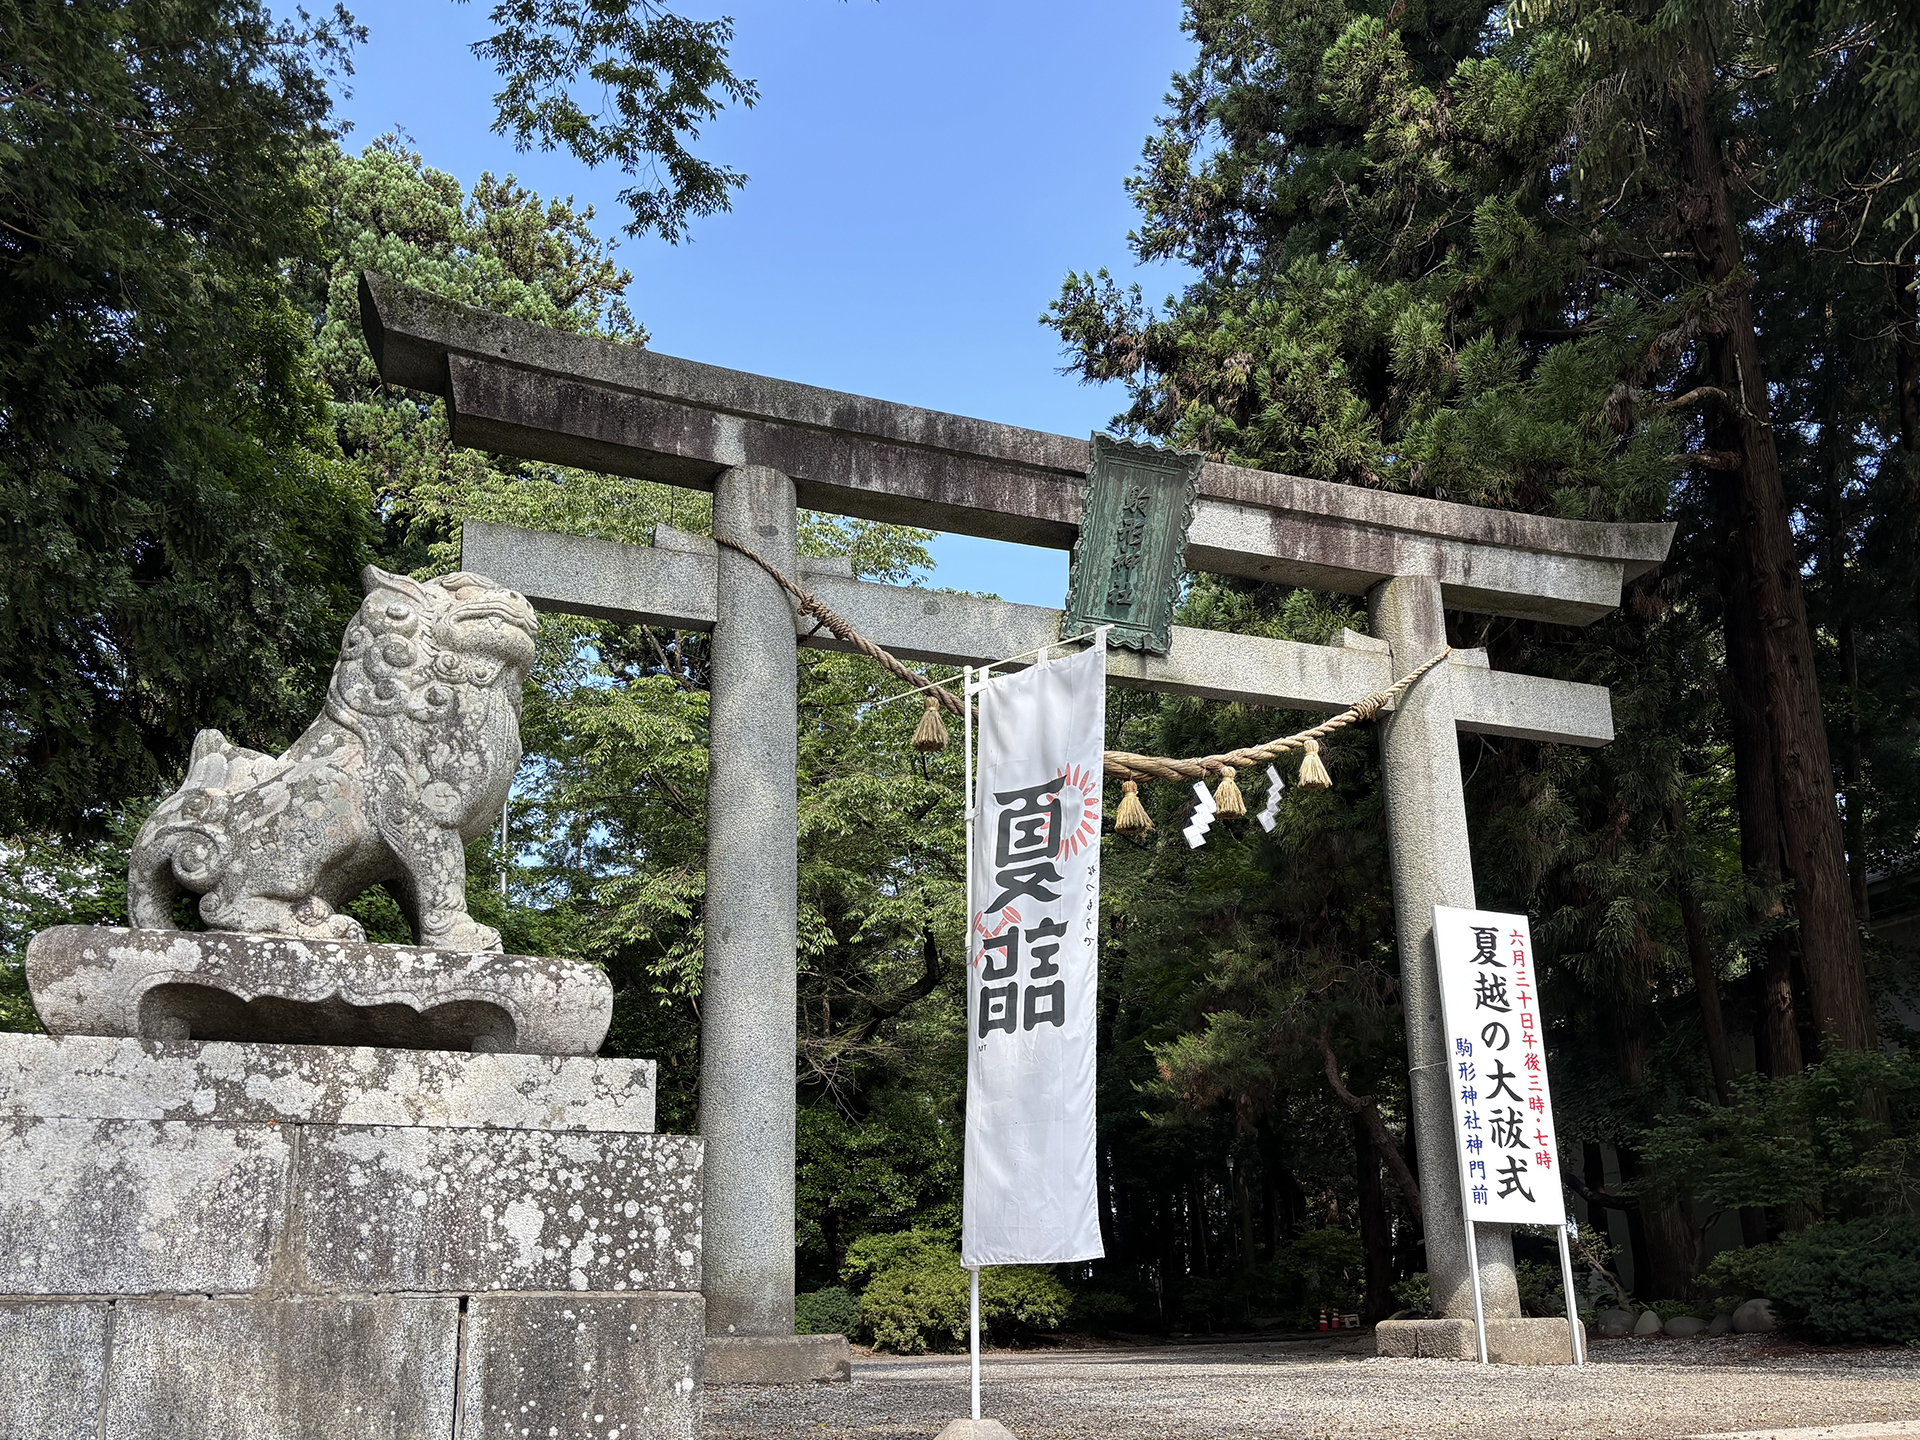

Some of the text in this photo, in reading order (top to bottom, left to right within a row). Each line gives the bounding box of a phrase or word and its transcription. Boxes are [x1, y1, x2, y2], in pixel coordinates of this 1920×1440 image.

[1455, 1037, 1489, 1206] 駒形神社神門前
[1469, 926, 1536, 1203] 夏越の大祓式
